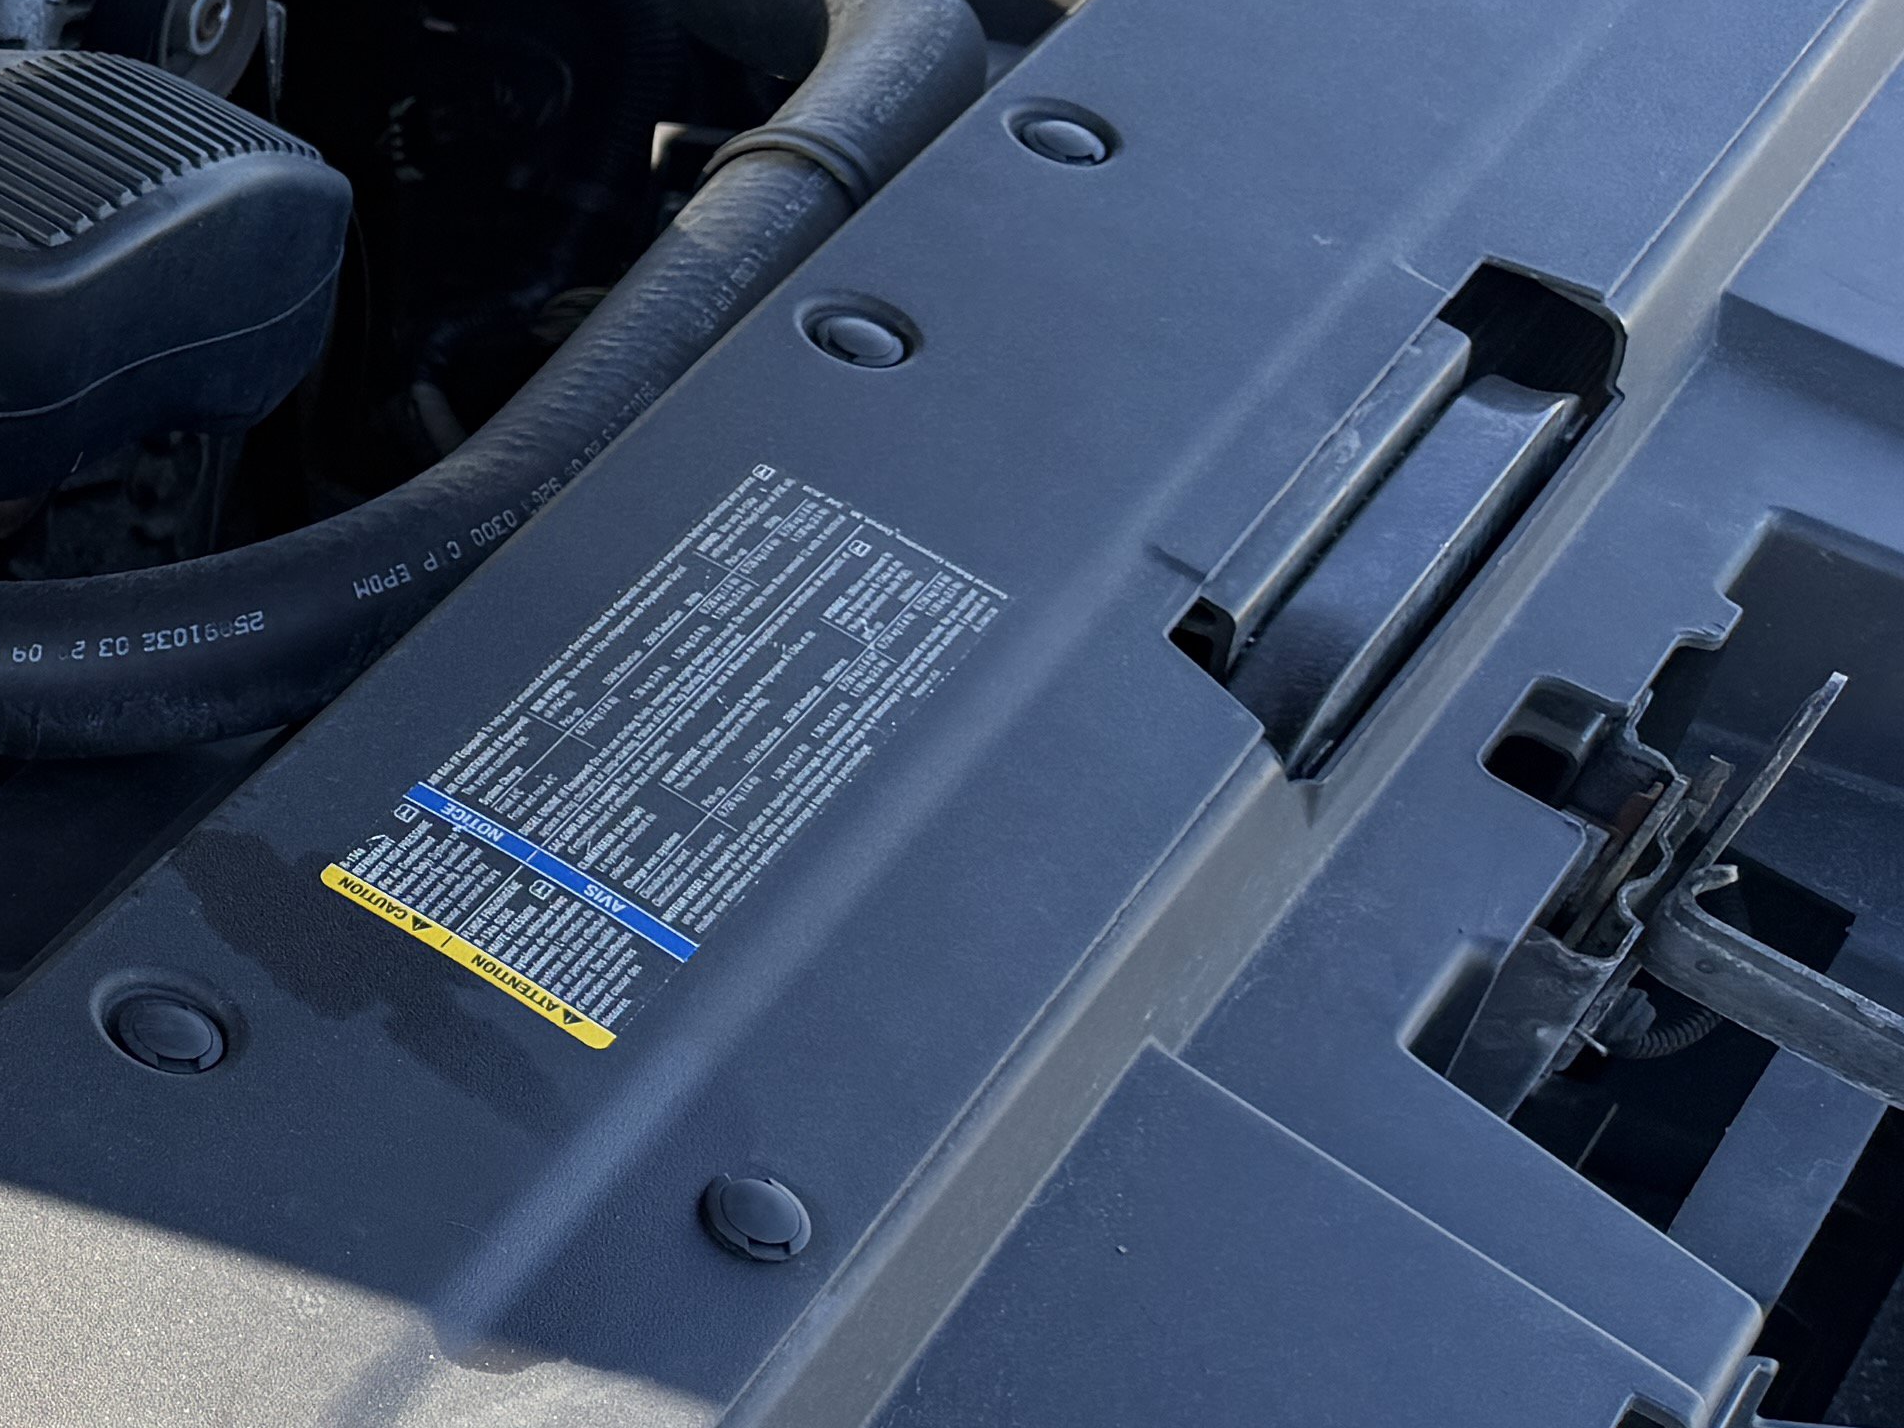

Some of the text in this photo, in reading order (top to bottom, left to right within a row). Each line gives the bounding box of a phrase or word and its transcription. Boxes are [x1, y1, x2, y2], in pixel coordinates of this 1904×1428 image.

[468, 508, 518, 548] 0300
[421, 539, 462, 571] CP
[352, 562, 412, 600] EPDM
[11, 642, 45, 665] 09
[98, 634, 130, 657] 03
[440, 801, 501, 842] NOTICE
[338, 876, 407, 921] CAUTION
[583, 883, 626, 913] AVIS
[471, 954, 560, 1012] ATTENTION
